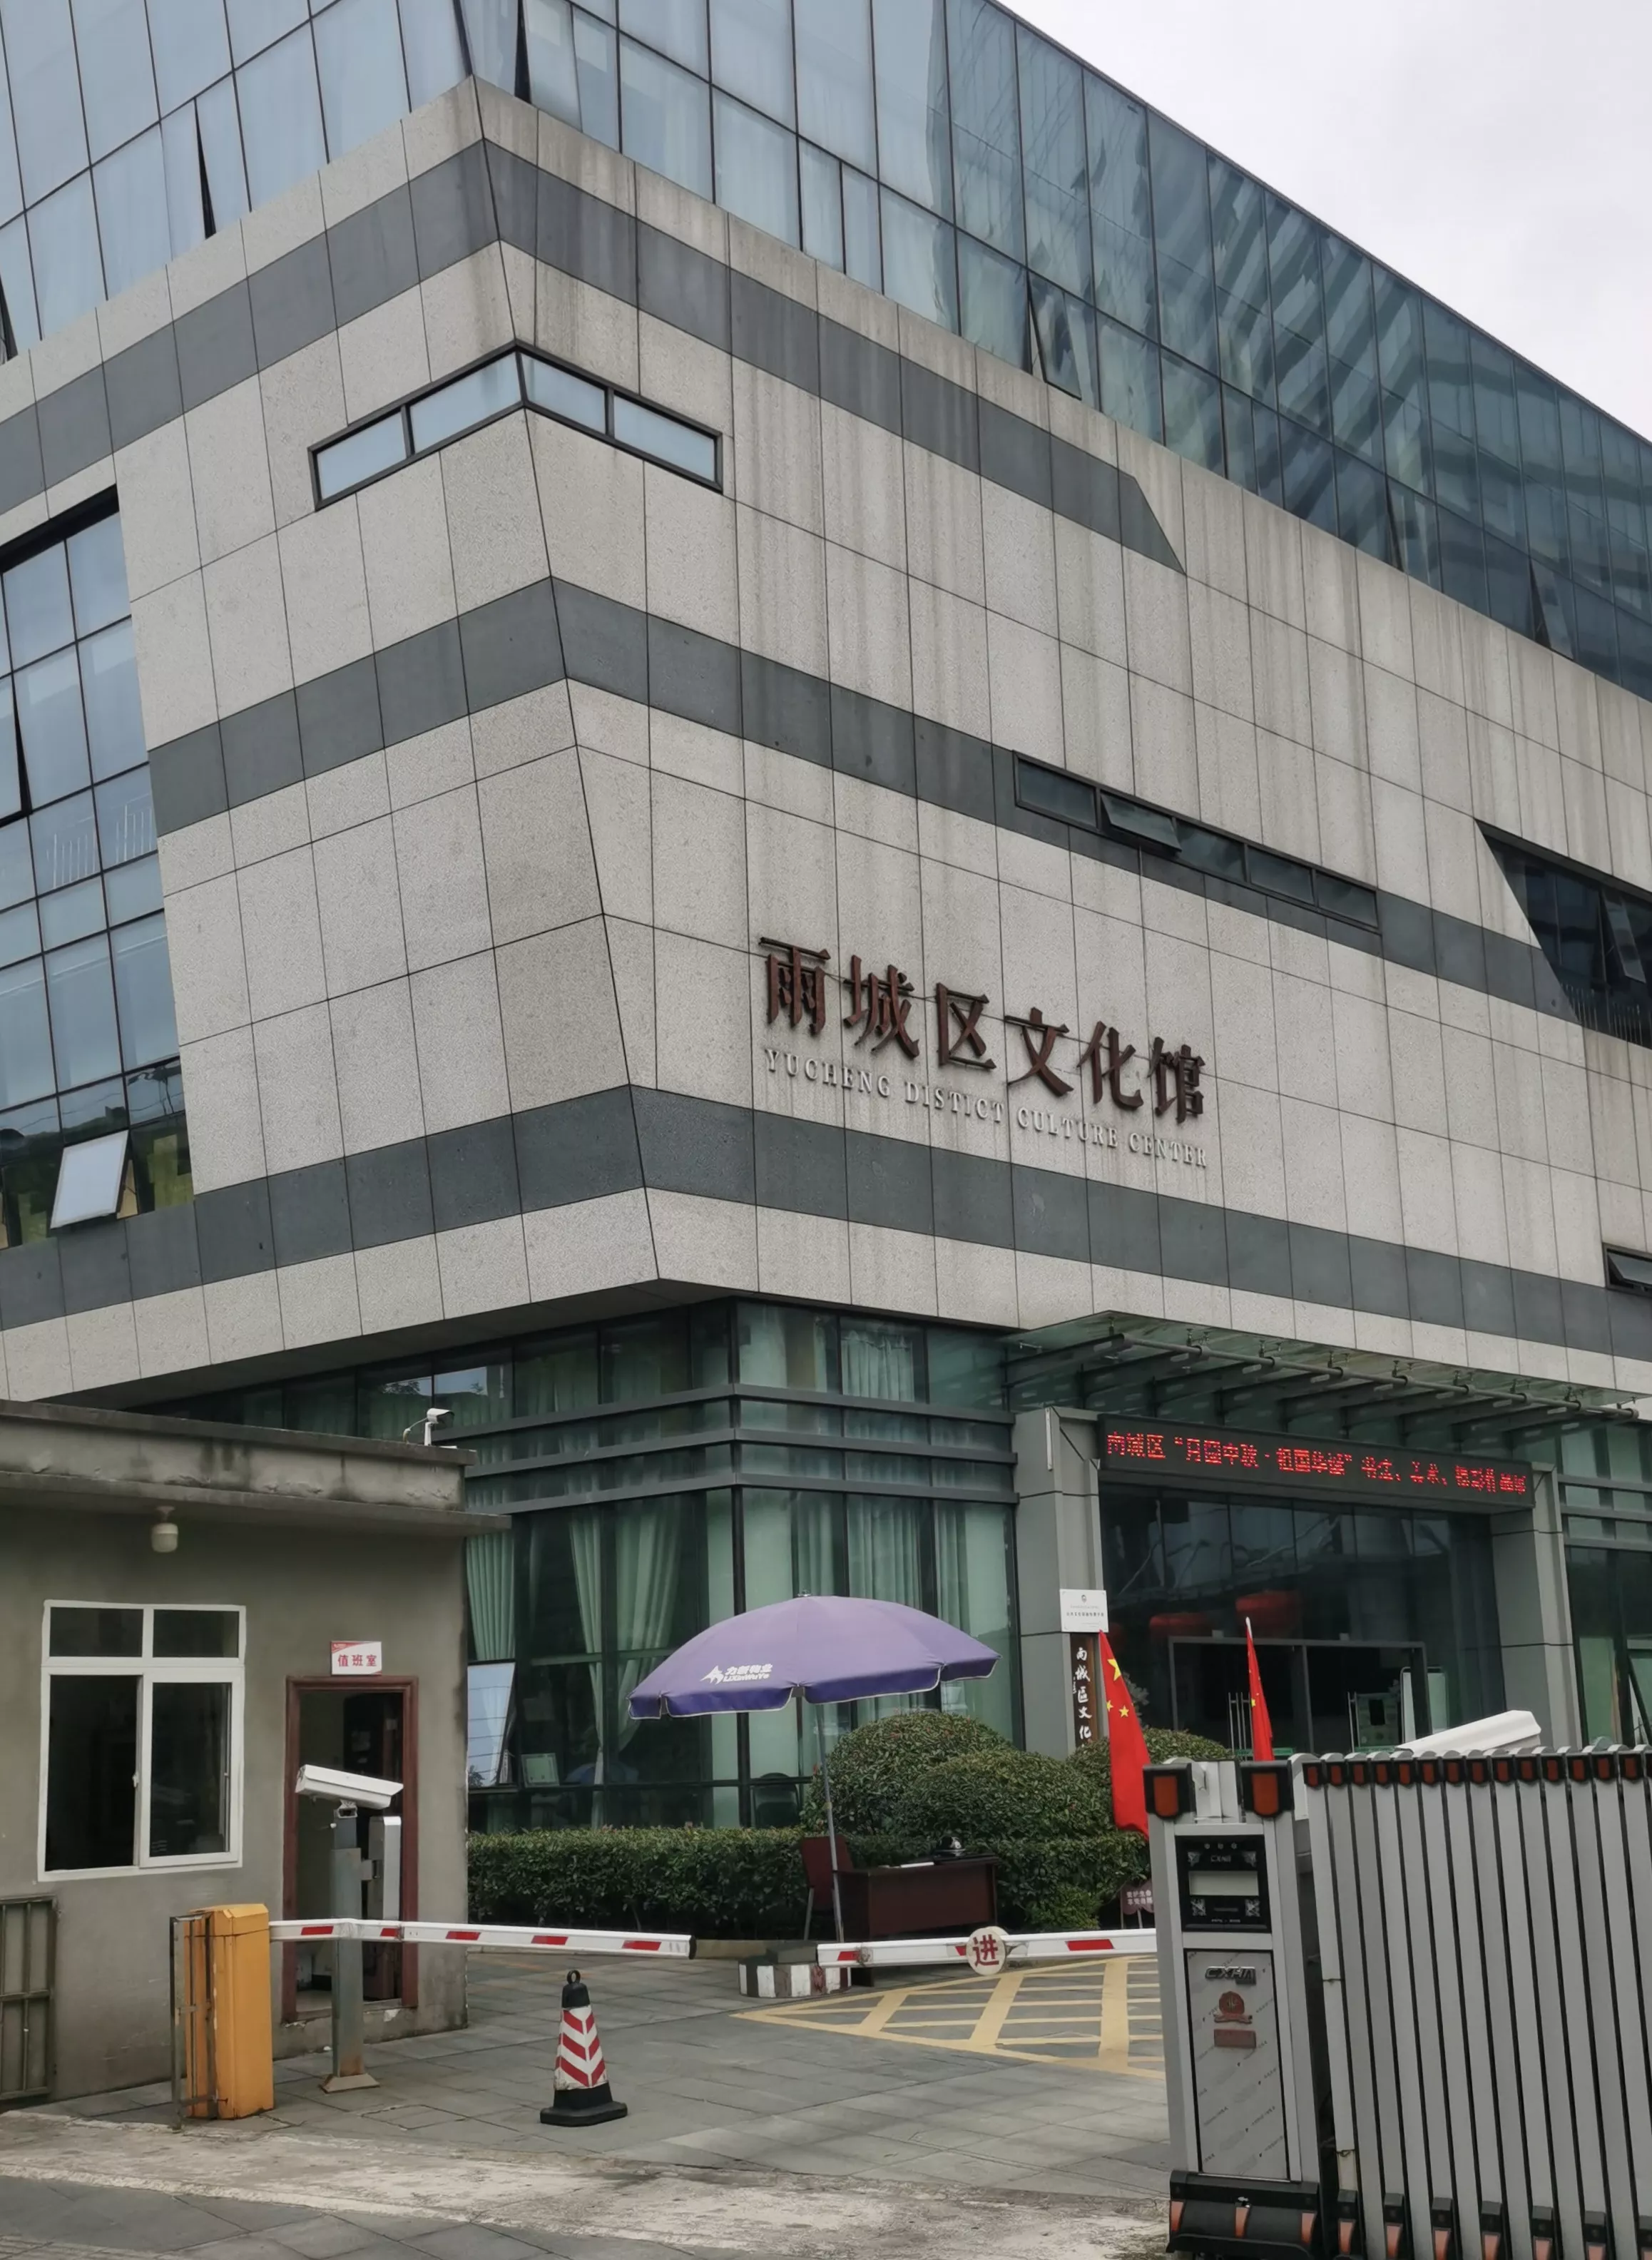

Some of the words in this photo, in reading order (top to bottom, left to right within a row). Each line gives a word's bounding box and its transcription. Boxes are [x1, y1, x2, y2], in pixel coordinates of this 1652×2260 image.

[759, 937, 1206, 1124] 雨城区文化馆
[765, 1048, 891, 1097] YUCHENG
[904, 1081, 1004, 1123] DISTICT
[1017, 1106, 1118, 1149] CULTURE
[1129, 1132, 1208, 1169] CENTER
[337, 1654, 377, 1667] 值班室
[1074, 1646, 1093, 1749] 雨城區文化
[972, 1934, 999, 1967] 进
